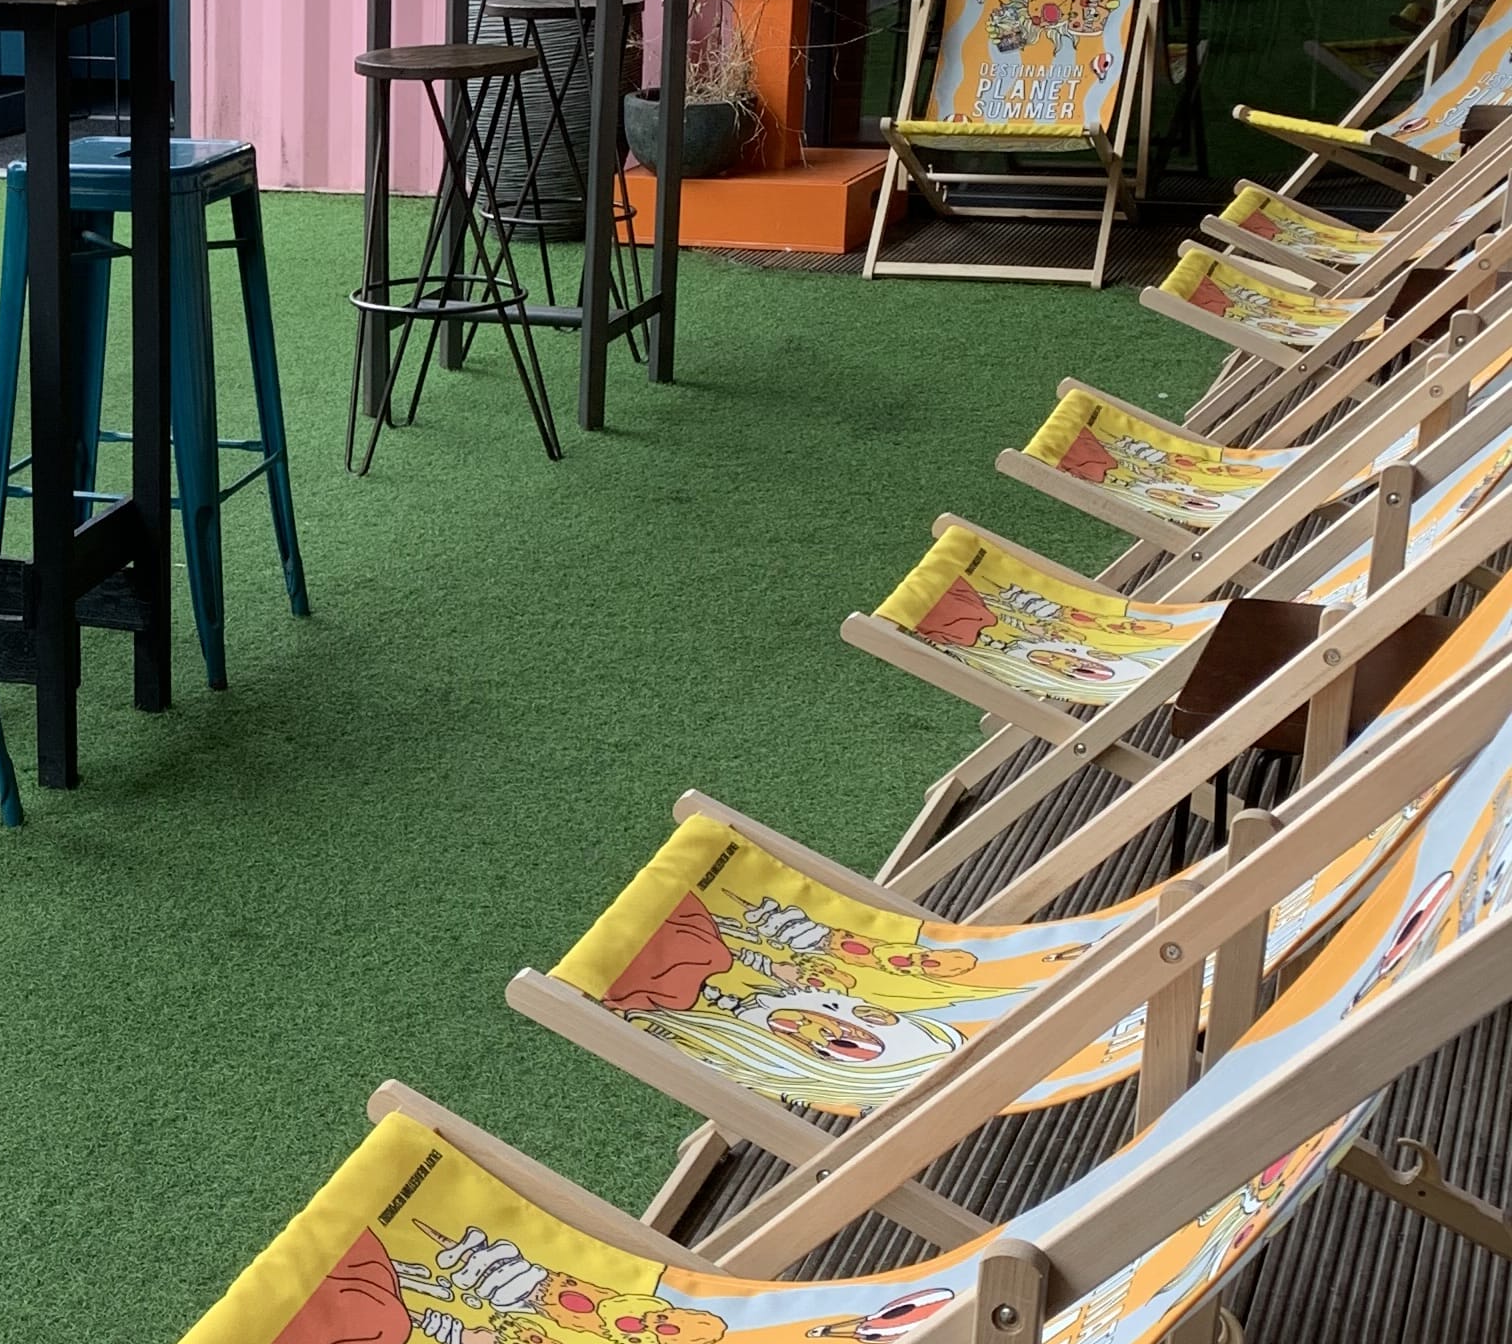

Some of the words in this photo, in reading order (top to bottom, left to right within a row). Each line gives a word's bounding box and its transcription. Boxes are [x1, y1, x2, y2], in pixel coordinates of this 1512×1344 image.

[979, 62, 1085, 78] DESTINATION
[975, 78, 1082, 101] PLANET
[972, 100, 1076, 120] SUMMER
